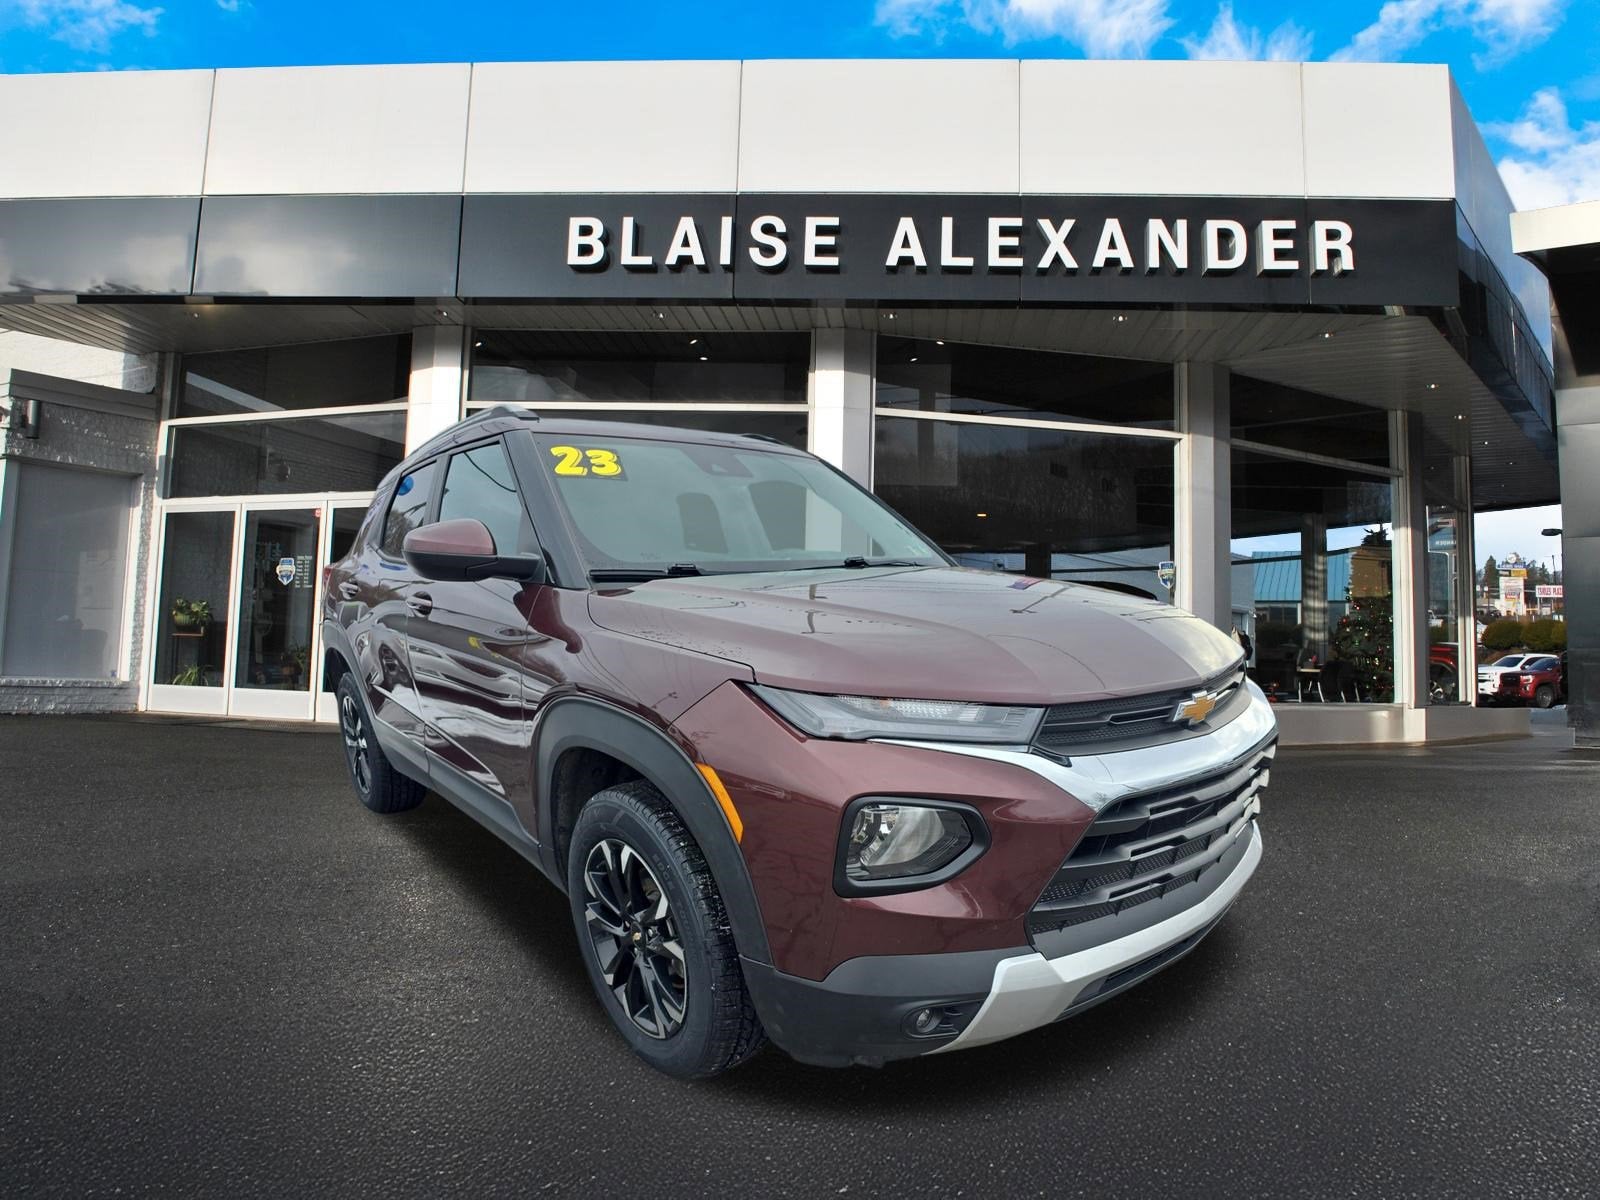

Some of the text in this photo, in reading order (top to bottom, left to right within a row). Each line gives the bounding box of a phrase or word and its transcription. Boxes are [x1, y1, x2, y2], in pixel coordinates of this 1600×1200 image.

[567, 215, 1355, 272] BLAISE ALEXANDER
[550, 446, 621, 476] 23
